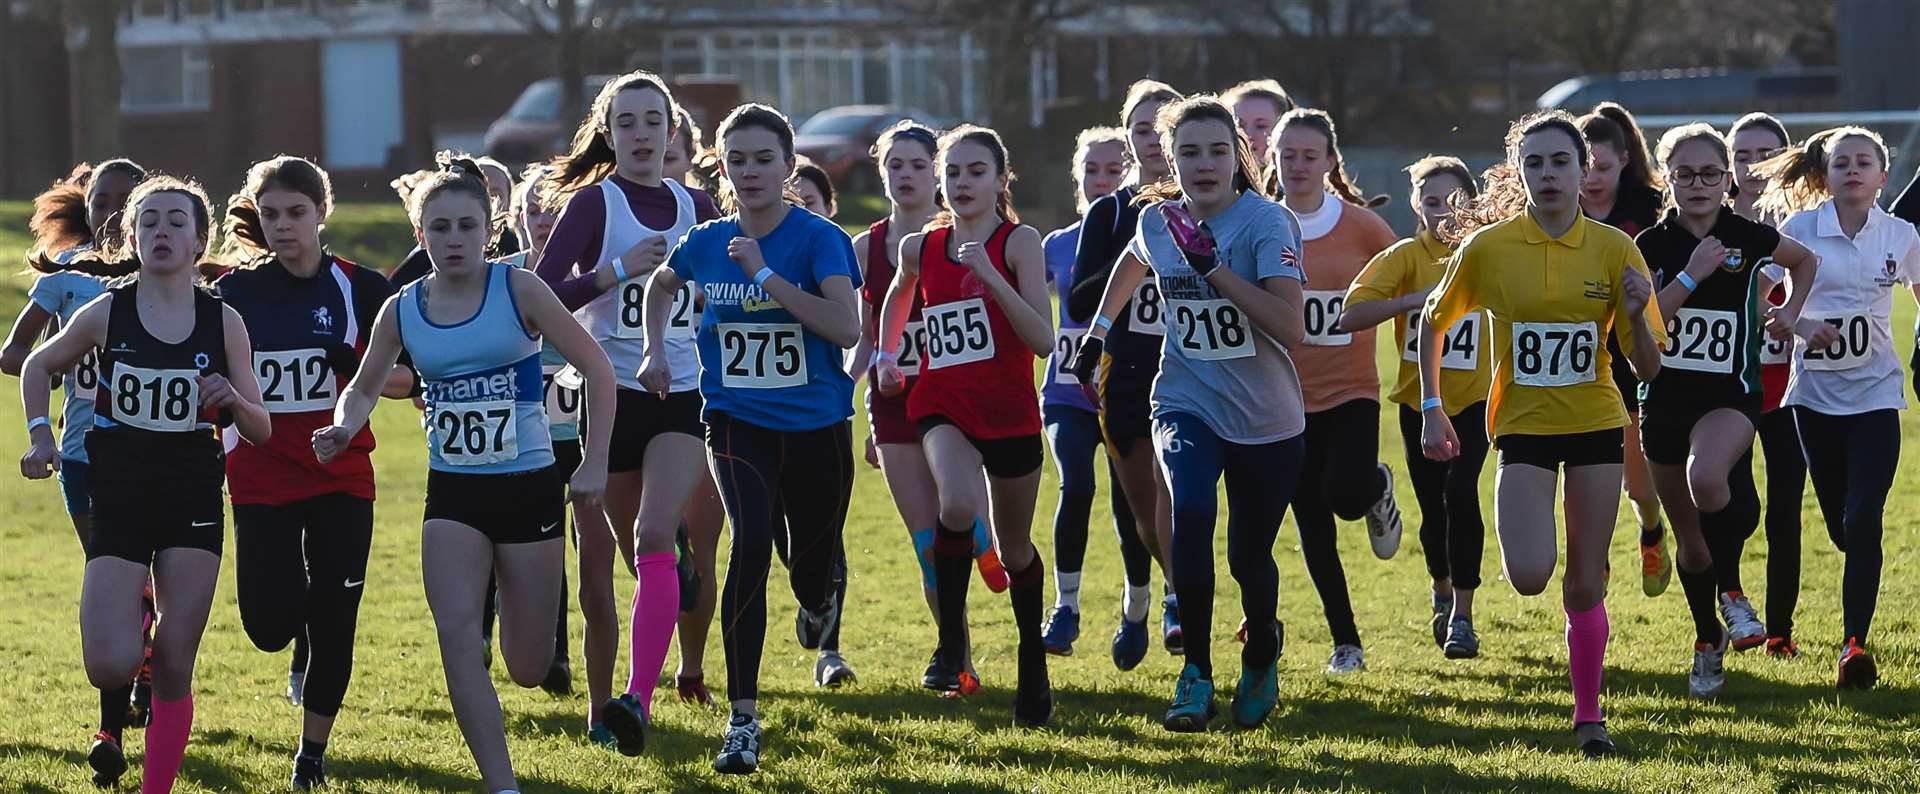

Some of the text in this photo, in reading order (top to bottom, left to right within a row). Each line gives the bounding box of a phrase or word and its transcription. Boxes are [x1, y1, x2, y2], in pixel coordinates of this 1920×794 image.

[621, 283, 690, 329] 82
[1177, 305, 1245, 350] 218
[724, 330, 800, 377] 275
[926, 306, 989, 359] 855
[1408, 312, 1475, 360] 24
[1518, 329, 1593, 376] 876
[117, 373, 191, 422] 818
[260, 355, 331, 402] 212
[437, 408, 511, 456] 267
